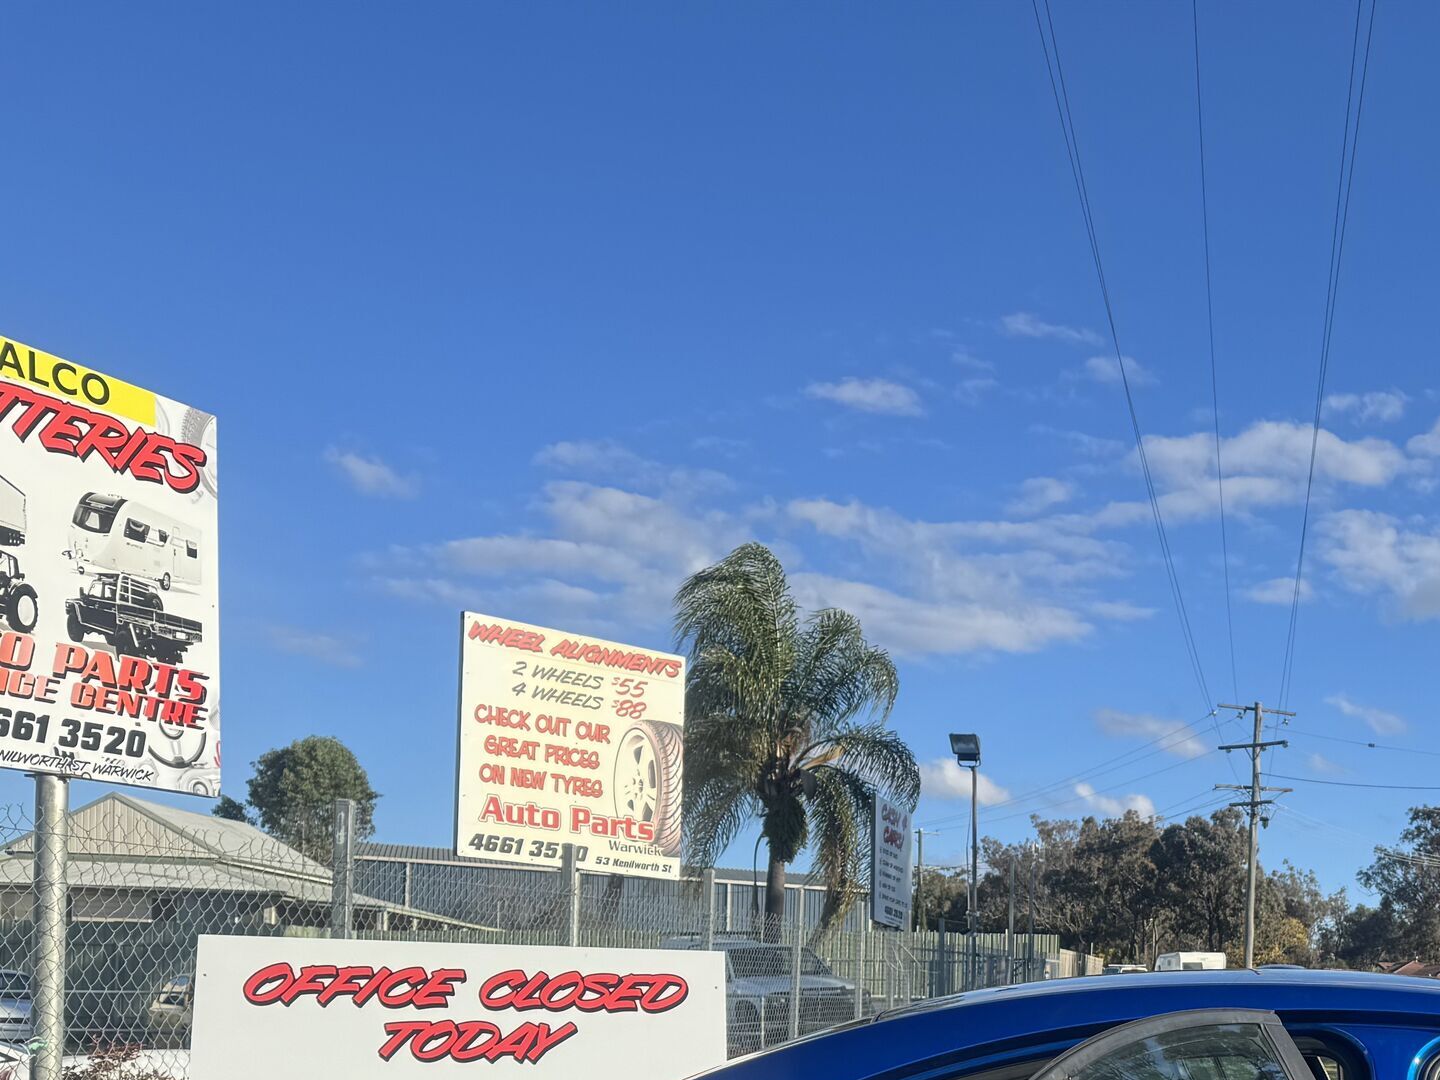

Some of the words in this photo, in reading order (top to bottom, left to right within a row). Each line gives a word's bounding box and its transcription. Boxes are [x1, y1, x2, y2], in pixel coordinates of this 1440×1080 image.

[467, 621, 546, 652] WHEEL
[550, 639, 682, 678] ALIGNMENTS
[53, 642, 210, 704] PARTS
[512, 661, 527, 676] 2
[531, 665, 604, 690] WHEELS
[611, 676, 649, 698] $55
[70, 682, 209, 730] CENTRE
[512, 682, 527, 696] 4
[531, 686, 604, 710] WHEELS
[611, 699, 647, 719] $88
[58, 718, 147, 758] 3520
[474, 704, 531, 731] CHECK
[535, 714, 571, 738] OUT
[575, 721, 611, 744] OUR
[484, 735, 540, 761] GREAT
[544, 744, 601, 769] PRICES
[92, 762, 154, 781] WARWICK
[479, 763, 505, 786] ON
[510, 768, 547, 790] NEW
[551, 774, 603, 798] TYRES
[480, 794, 560, 829] Auto
[570, 805, 655, 842] Parts
[468, 833, 525, 854] 4661
[529, 839, 589, 862] 350
[595, 856, 610, 867] 53
[612, 858, 660, 872] Kenilworth
[662, 863, 672, 874] St
[608, 840, 662, 857] Warwick
[242, 962, 467, 1010] OFFICE
[478, 969, 689, 1014] CLOSED
[378, 1020, 579, 1065] TODAY
